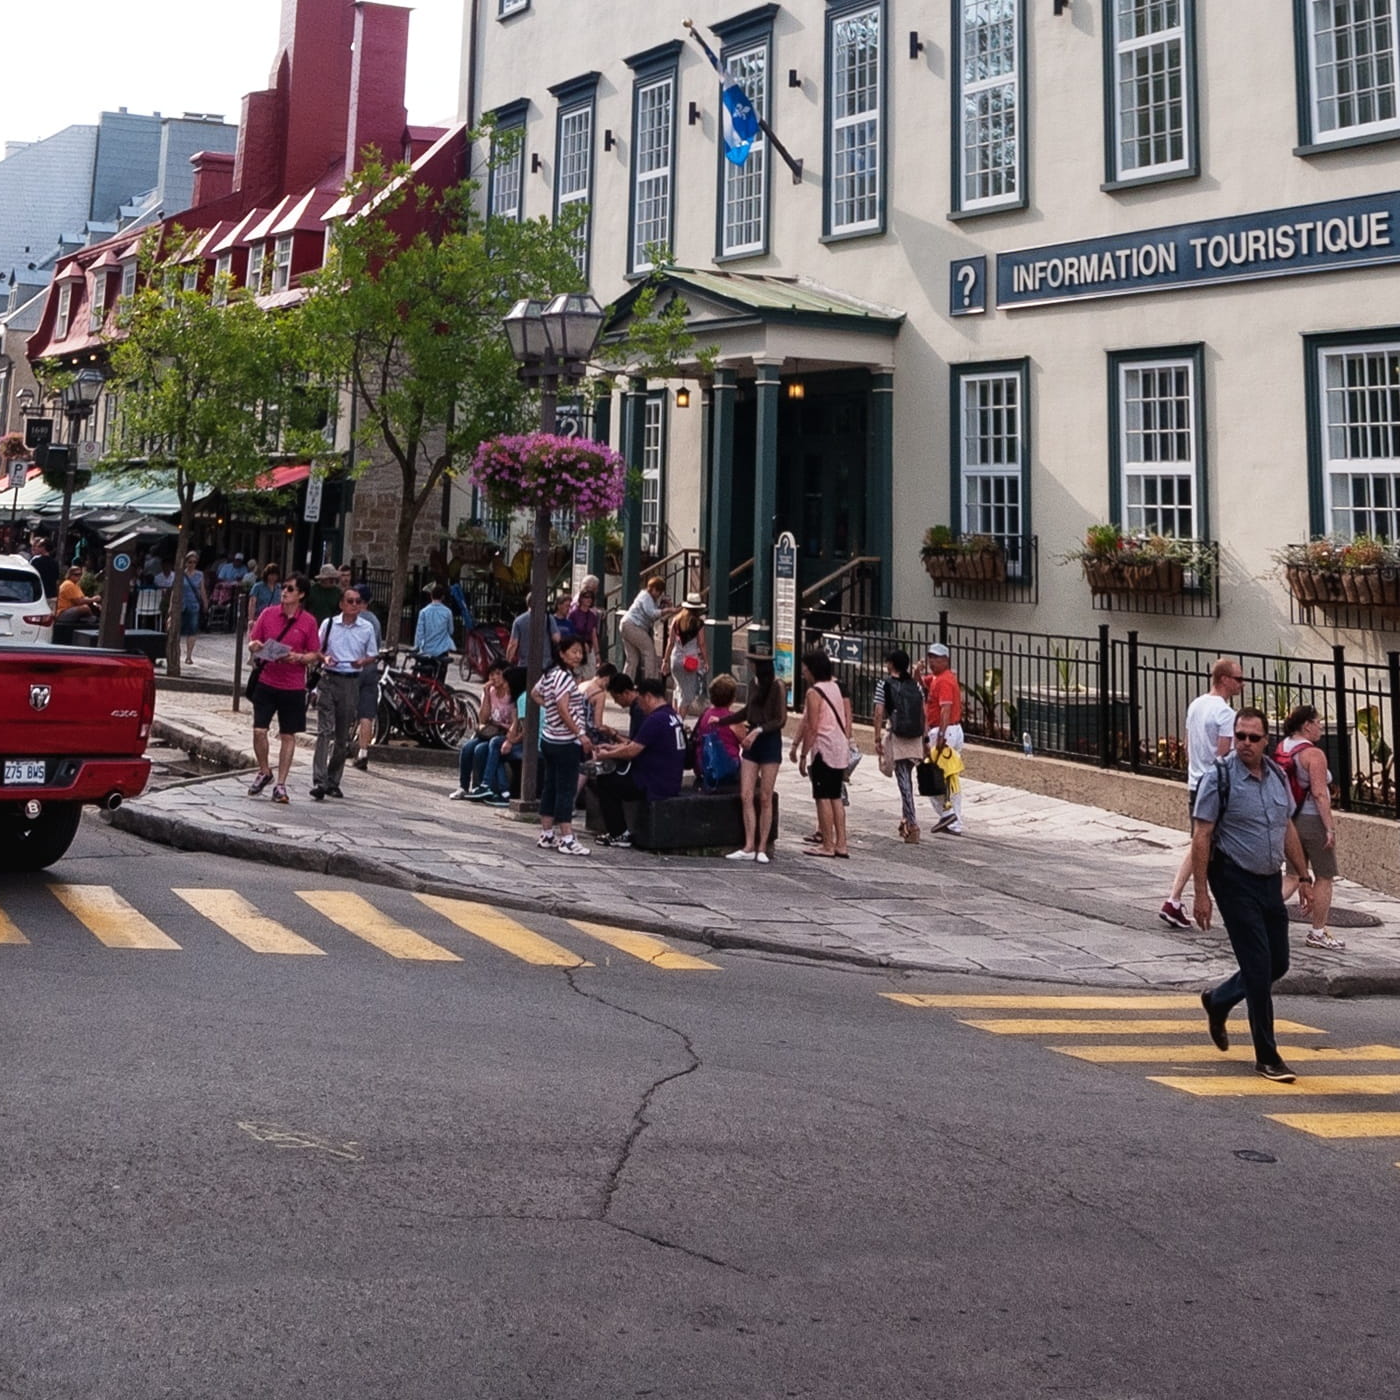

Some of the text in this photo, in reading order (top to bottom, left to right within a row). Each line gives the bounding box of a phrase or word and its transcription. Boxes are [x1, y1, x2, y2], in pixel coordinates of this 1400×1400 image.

[1012, 210, 1391, 293] INFORMATION TOURISTIQUE
[957, 264, 977, 306] ?
[14, 463, 23, 475] P
[4, 765, 23, 780] Z75
